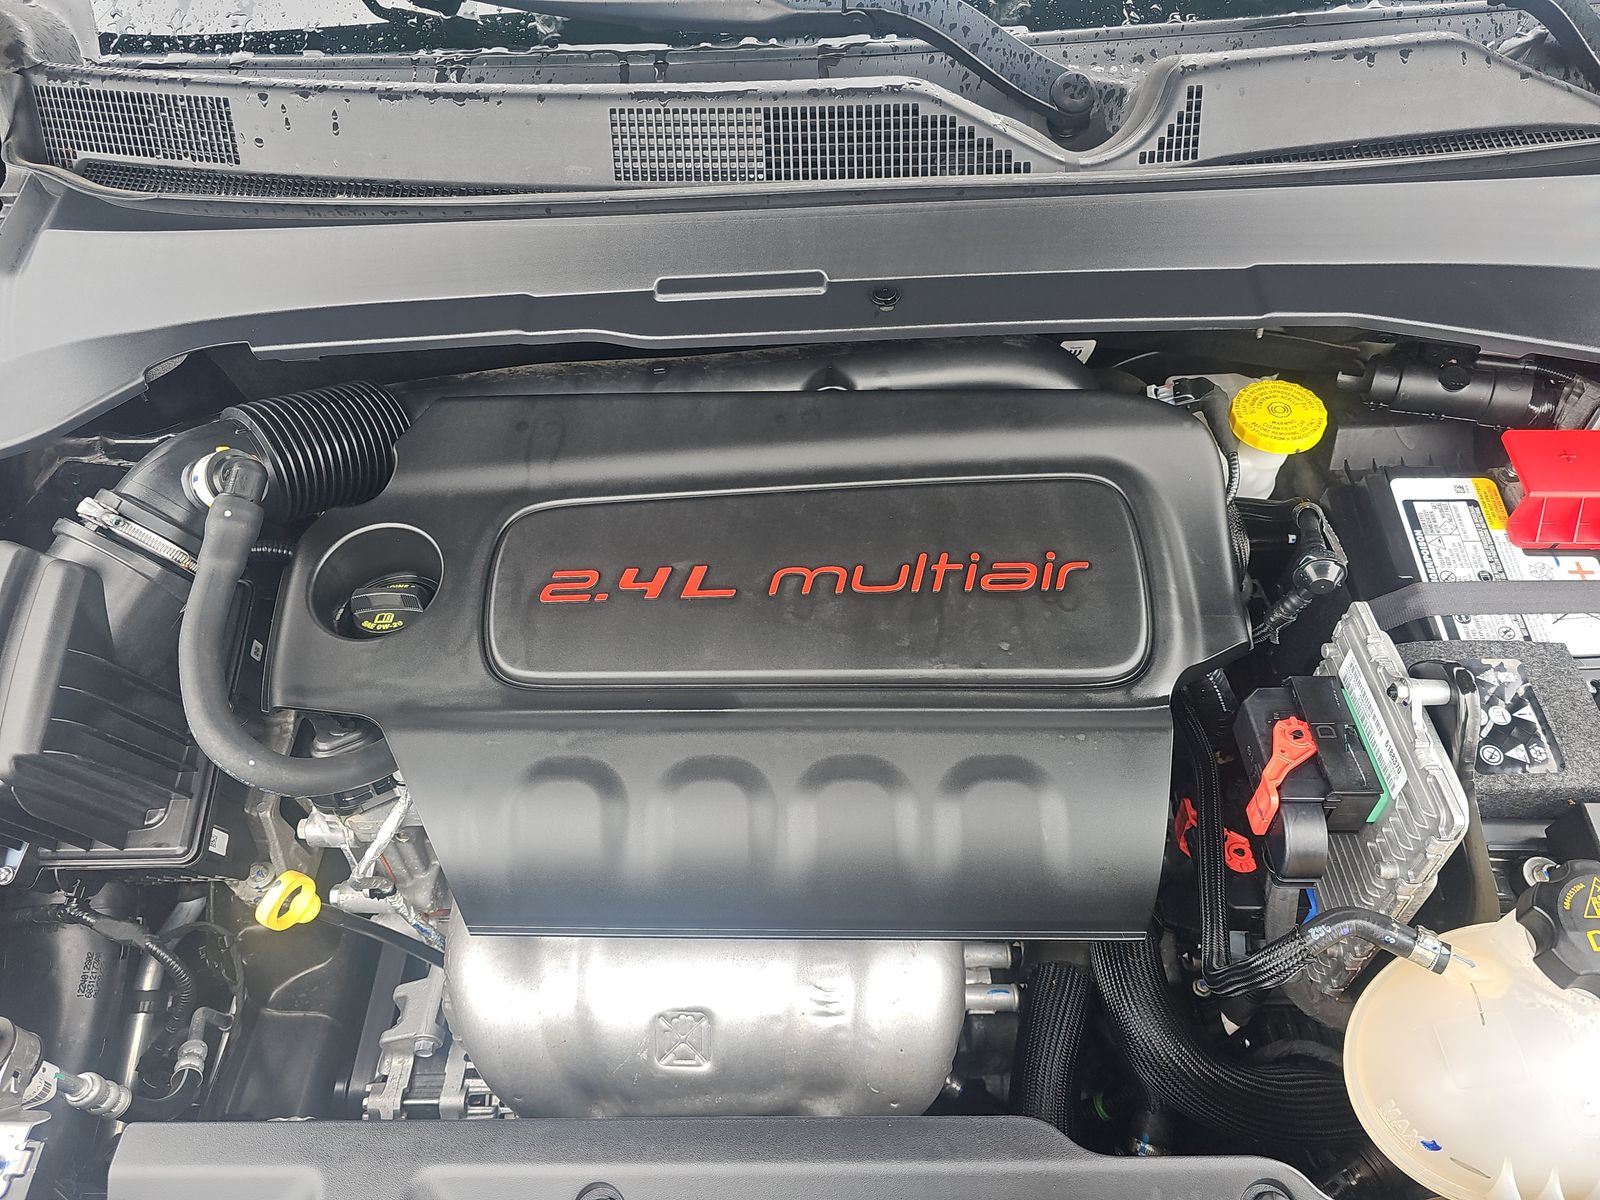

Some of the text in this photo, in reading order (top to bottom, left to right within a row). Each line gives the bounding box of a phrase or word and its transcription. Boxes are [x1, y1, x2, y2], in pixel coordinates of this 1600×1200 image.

[539, 551, 1091, 603] 2.4L multiair
[362, 620, 403, 630] SAE 0W-20
